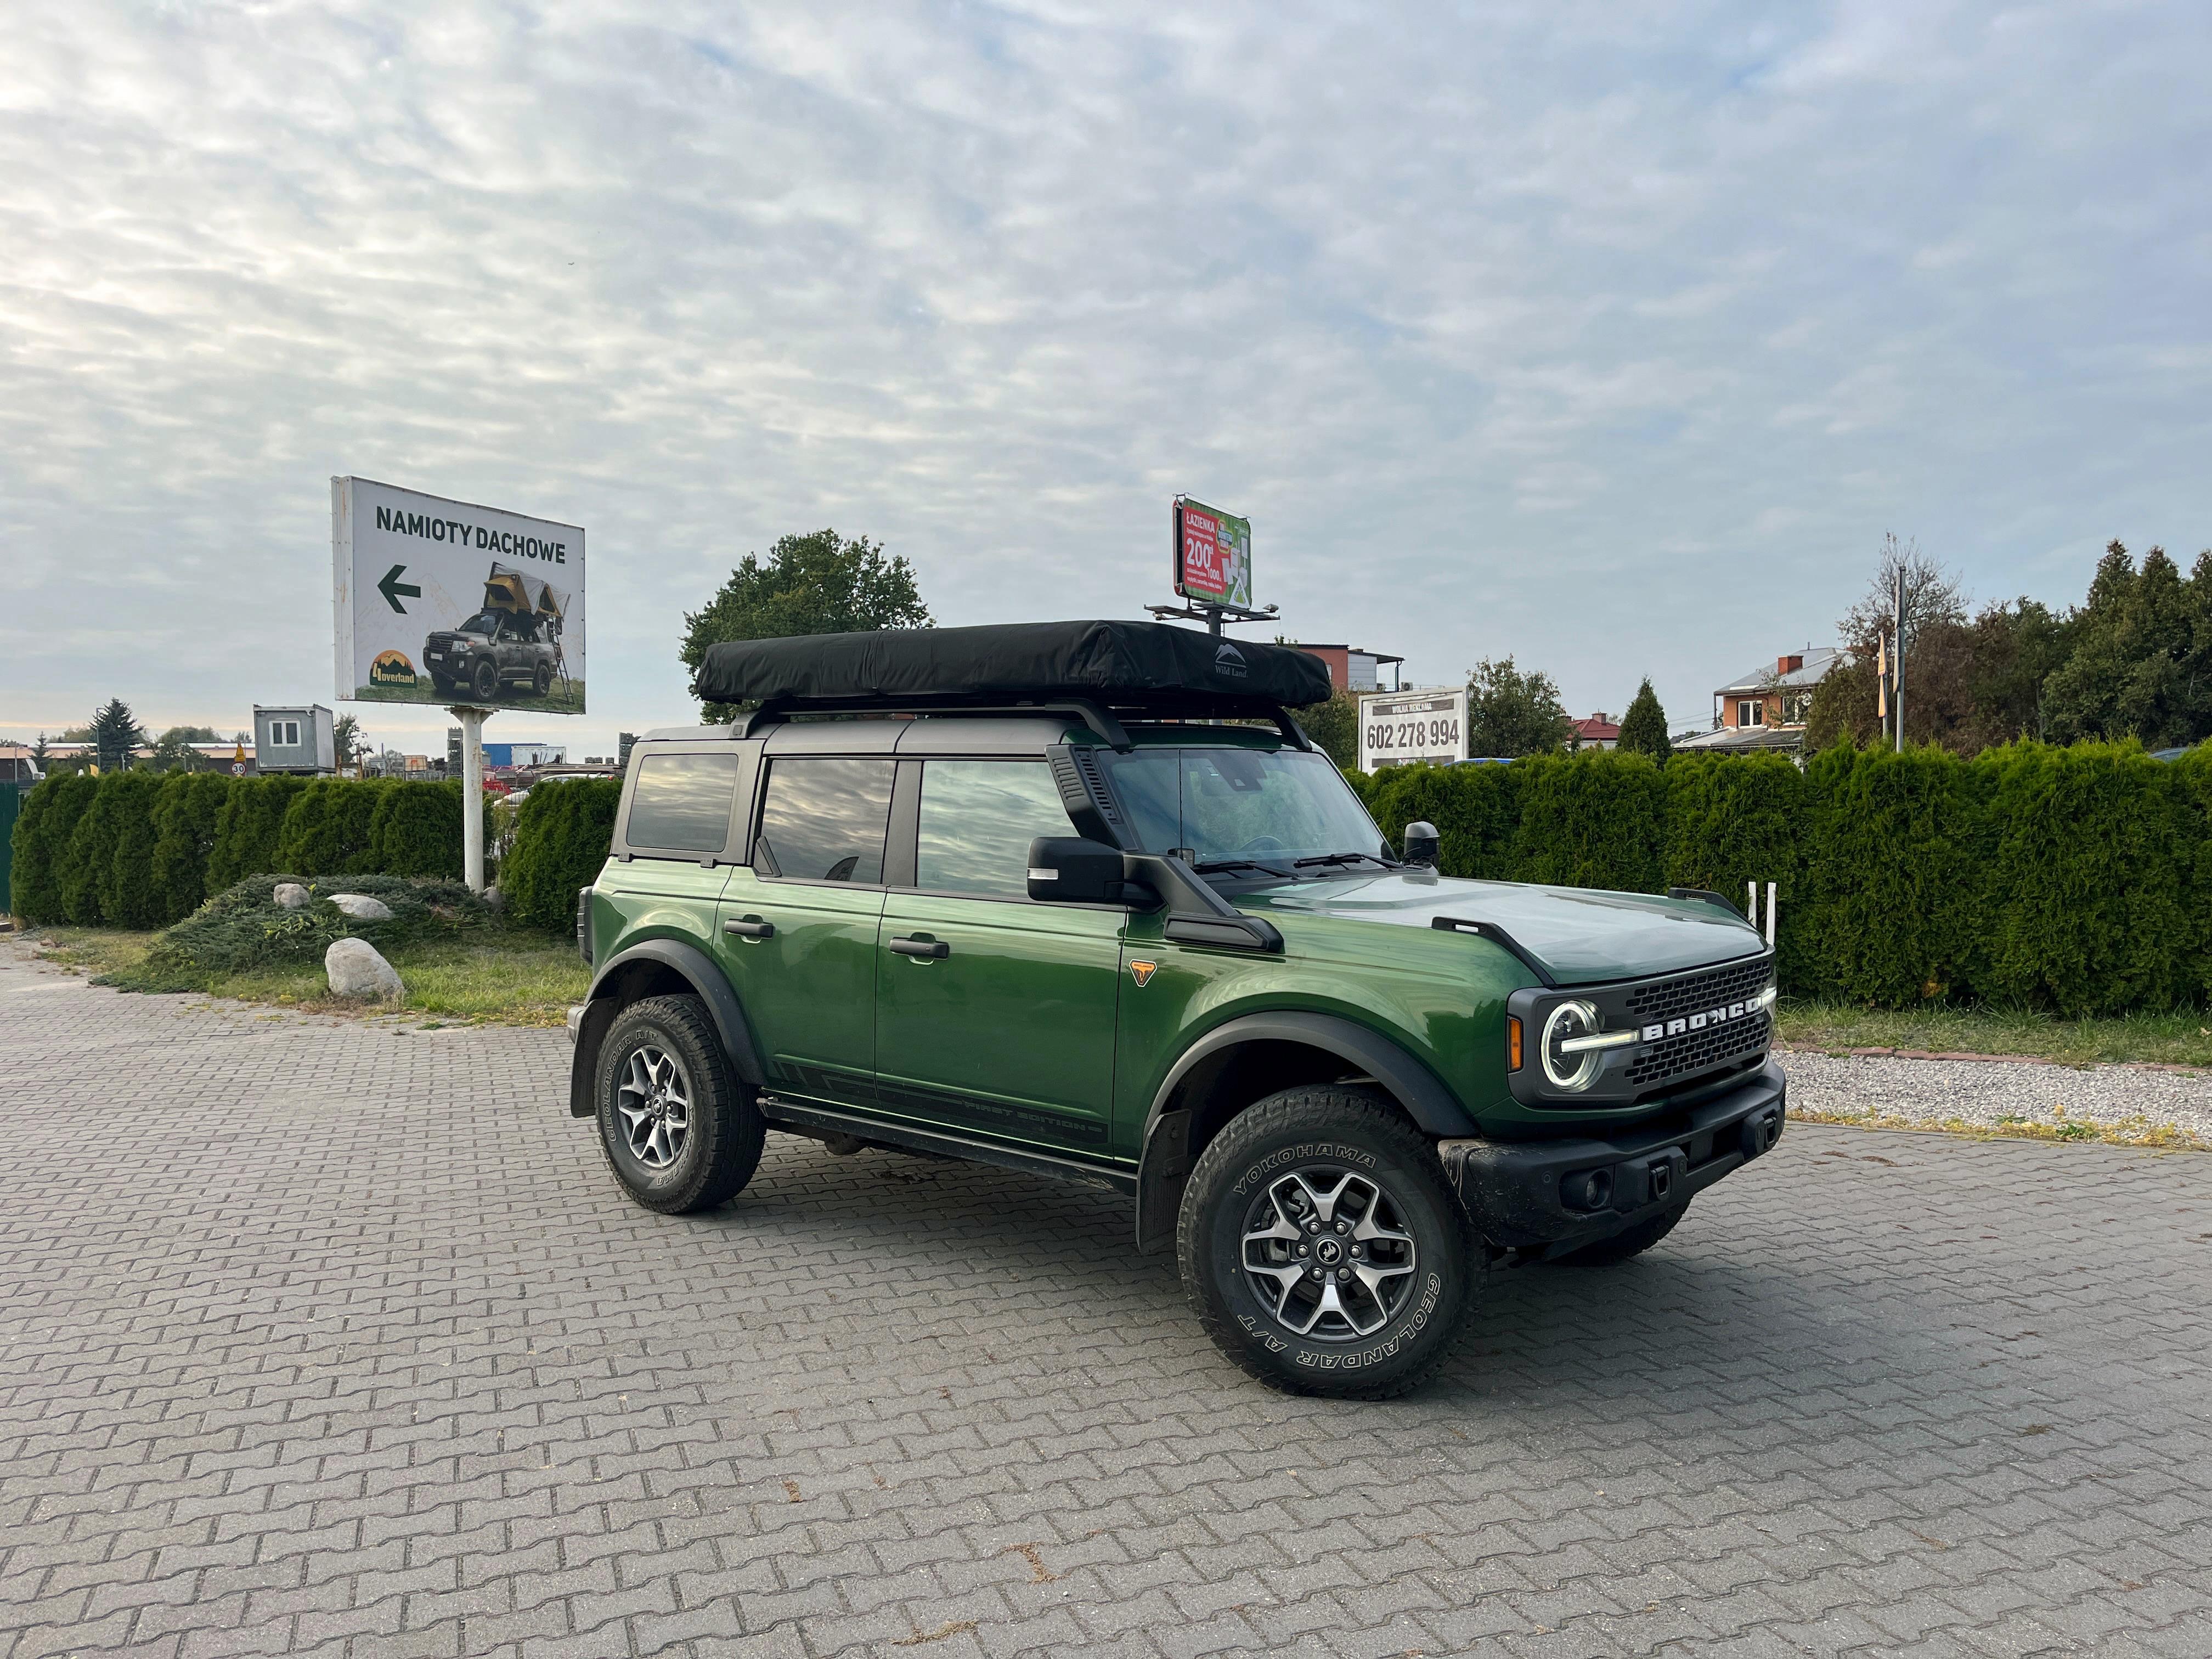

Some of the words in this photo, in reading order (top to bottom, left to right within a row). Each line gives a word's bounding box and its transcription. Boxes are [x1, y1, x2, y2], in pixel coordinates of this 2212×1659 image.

[376, 506, 472, 546] NAMIOTY
[476, 527, 566, 564] DACHOWE
[1186, 512, 1215, 534] ŁAZIENKA
[1187, 538, 1211, 570] 200
[1207, 568, 1220, 580] 1000
[1215, 665, 1230, 675] Wild
[1232, 668, 1247, 678] Land
[1392, 704, 1408, 714] WOLNA
[1367, 725, 1393, 749] 602
[1398, 721, 1425, 747] 278
[1430, 719, 1459, 746] 994
[1643, 997, 1759, 1041] BRONCO
[603, 1035, 632, 1142] GEOLANDAR
[636, 1030, 658, 1040] A/T
[964, 1101, 1013, 1116] FIRST
[1017, 1111, 1086, 1131] EDITION
[1233, 1143, 1378, 1195] YOKOHAMA
[1237, 1314, 1288, 1353] A/T
[1296, 1273, 1441, 1369] GEOLANDAR
